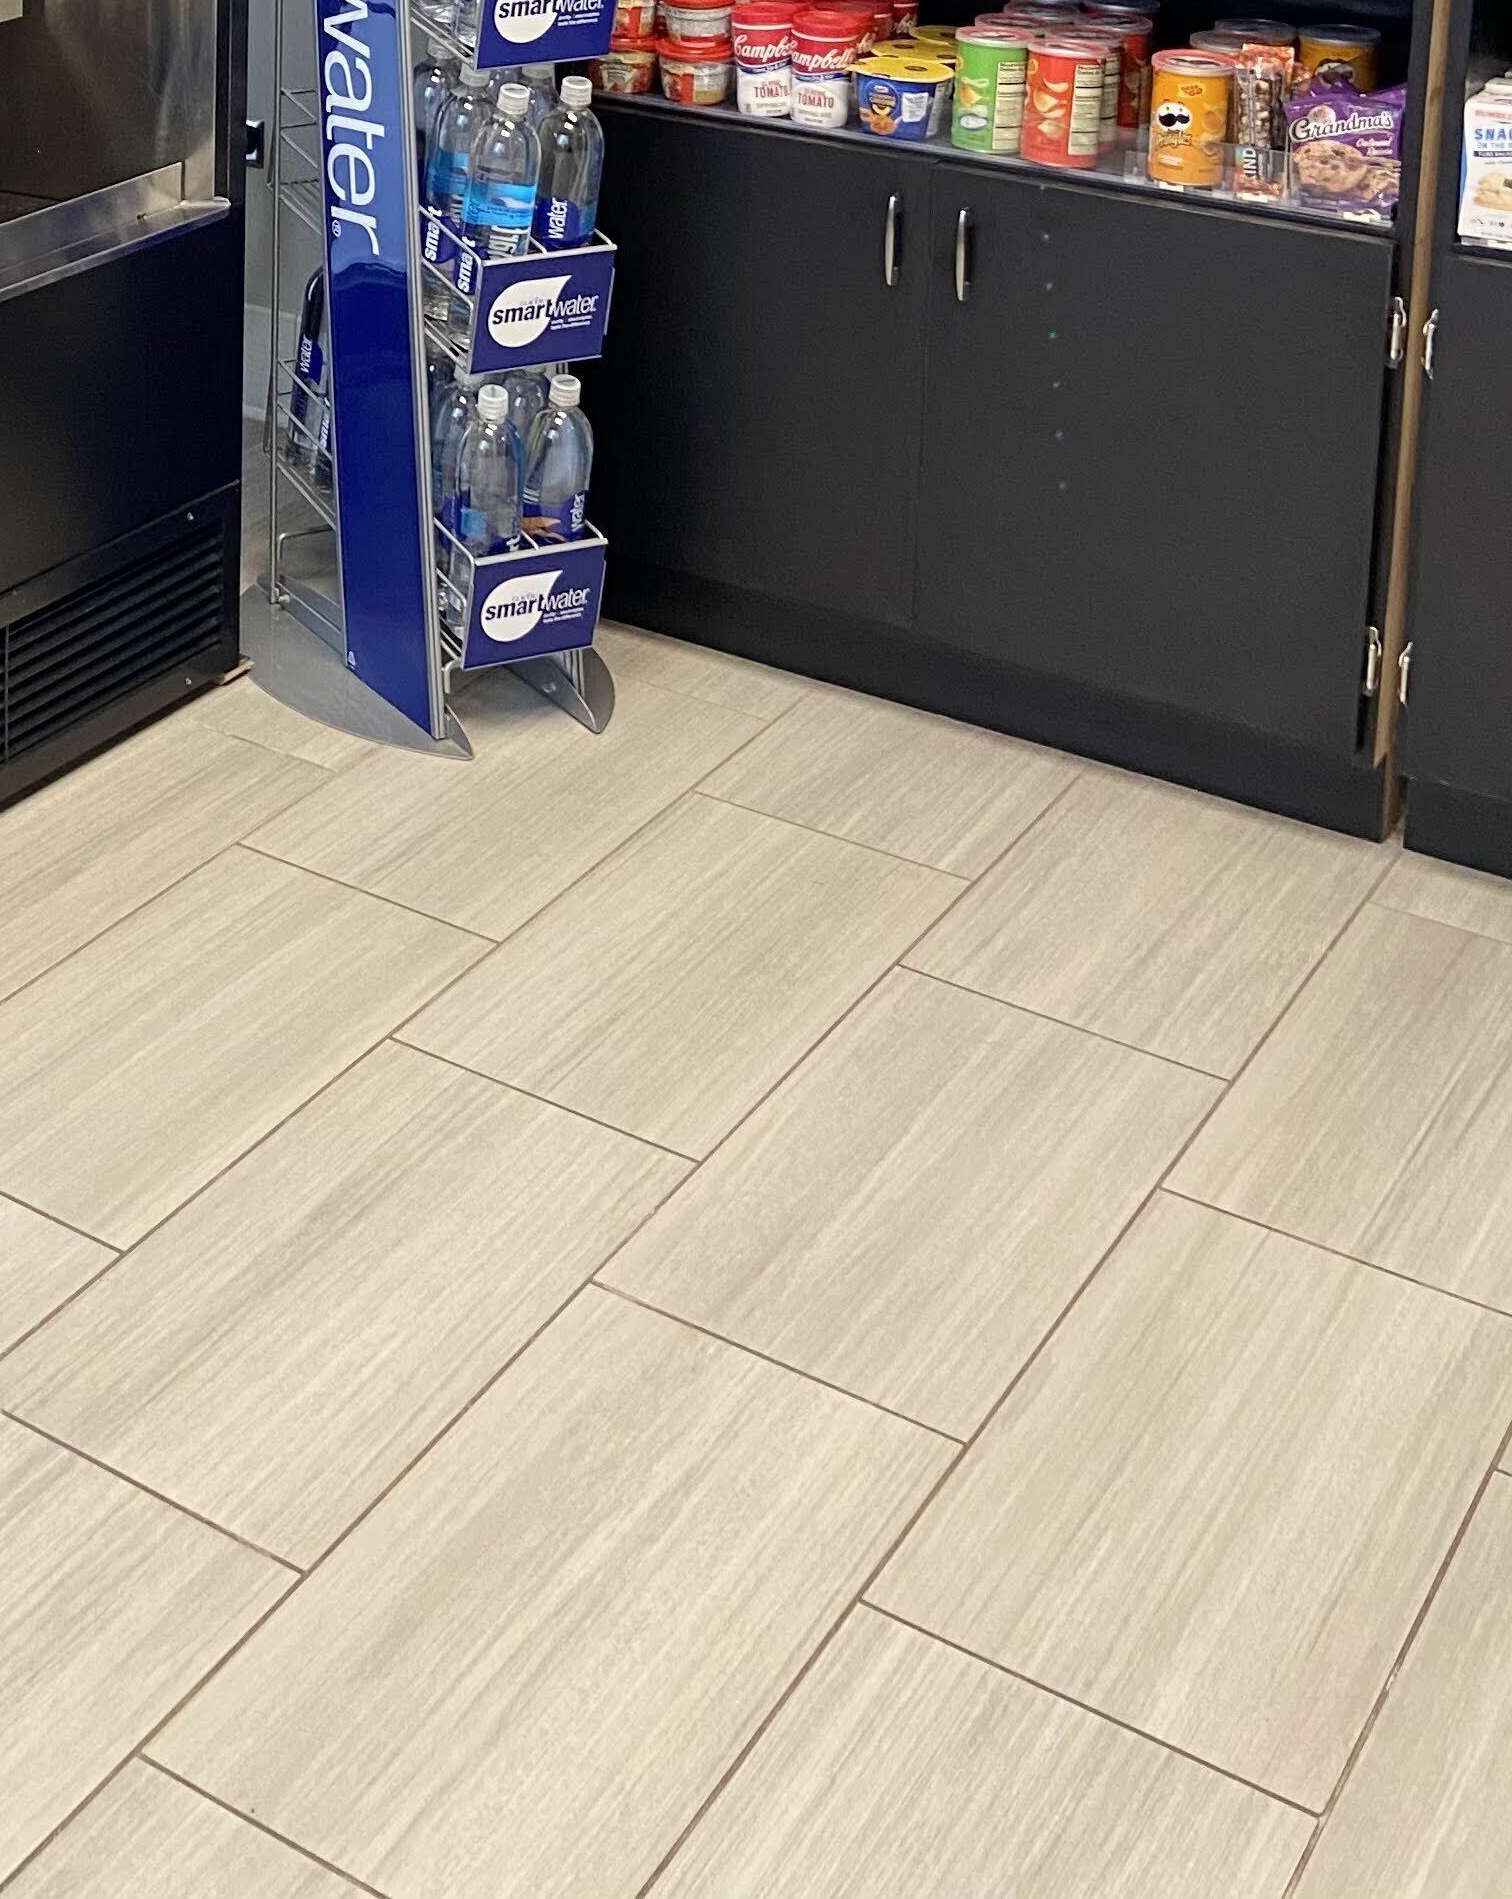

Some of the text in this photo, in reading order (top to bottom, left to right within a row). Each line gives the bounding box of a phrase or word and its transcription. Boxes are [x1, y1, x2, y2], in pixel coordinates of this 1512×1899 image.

[797, 92, 835, 109] TOMATO
[1291, 111, 1394, 141] Grandma's
[1474, 128, 1512, 141] SNA
[548, 197, 568, 239] water
[492, 294, 599, 325] smartwater
[484, 587, 590, 621] smartwater
